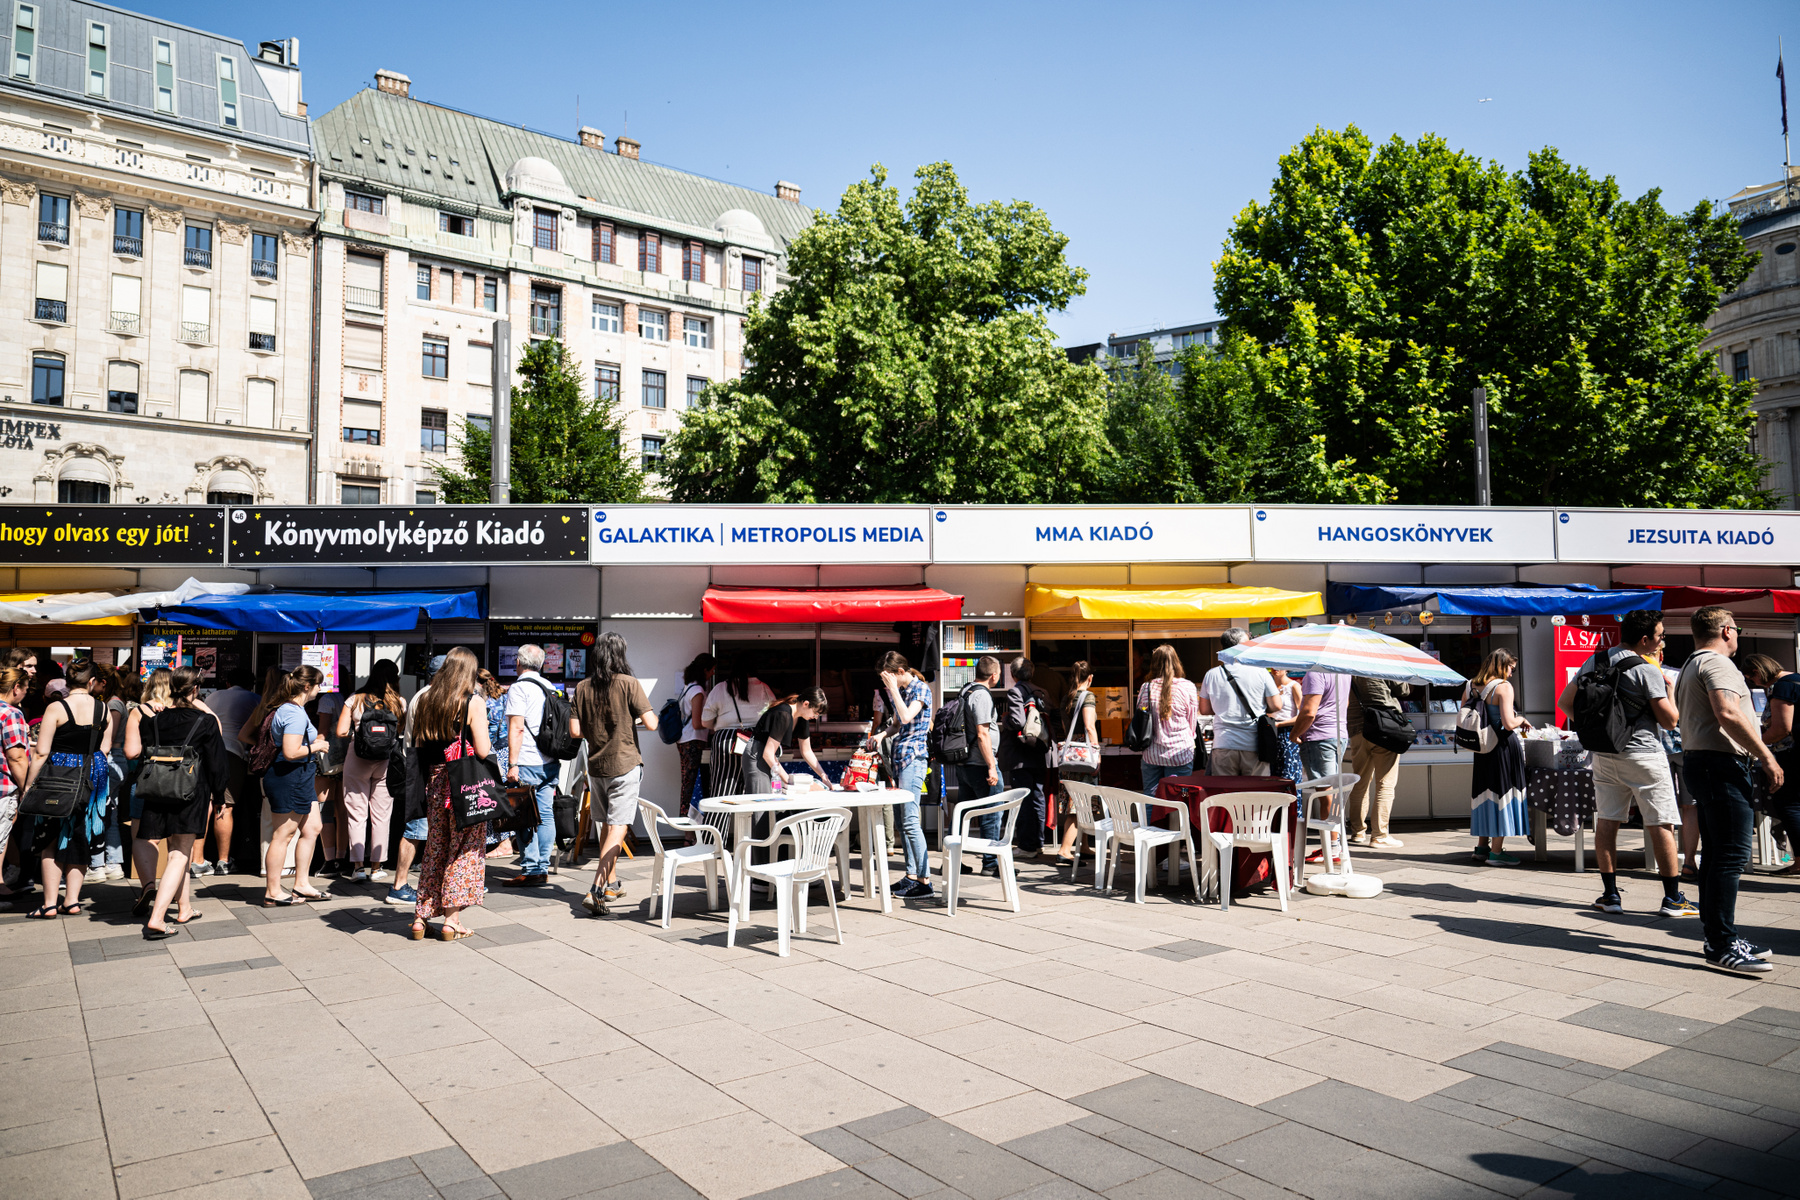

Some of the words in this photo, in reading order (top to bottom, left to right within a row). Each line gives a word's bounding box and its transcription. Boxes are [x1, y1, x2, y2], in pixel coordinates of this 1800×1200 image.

[234, 511, 245, 521] 46
[0, 523, 48, 546] hogy
[53, 523, 110, 542] olvass
[116, 527, 150, 546] egy
[153, 524, 190, 546] jót!
[264, 519, 469, 553] Könyvmolyképző
[476, 519, 545, 546] Kiadó
[599, 527, 715, 544] GALAKTIKA
[731, 526, 857, 543] METROPOLIS
[862, 526, 924, 543] MEDIA
[1035, 526, 1084, 542] MMA
[1089, 521, 1154, 542] KIADÓ
[1318, 523, 1494, 543] HANGOSKÖNYVEK
[1627, 528, 1712, 545] JEZSUITA
[1717, 526, 1775, 546] KIADÓ
[1563, 630, 1576, 646] A
[1579, 627, 1616, 646] SZÍV
